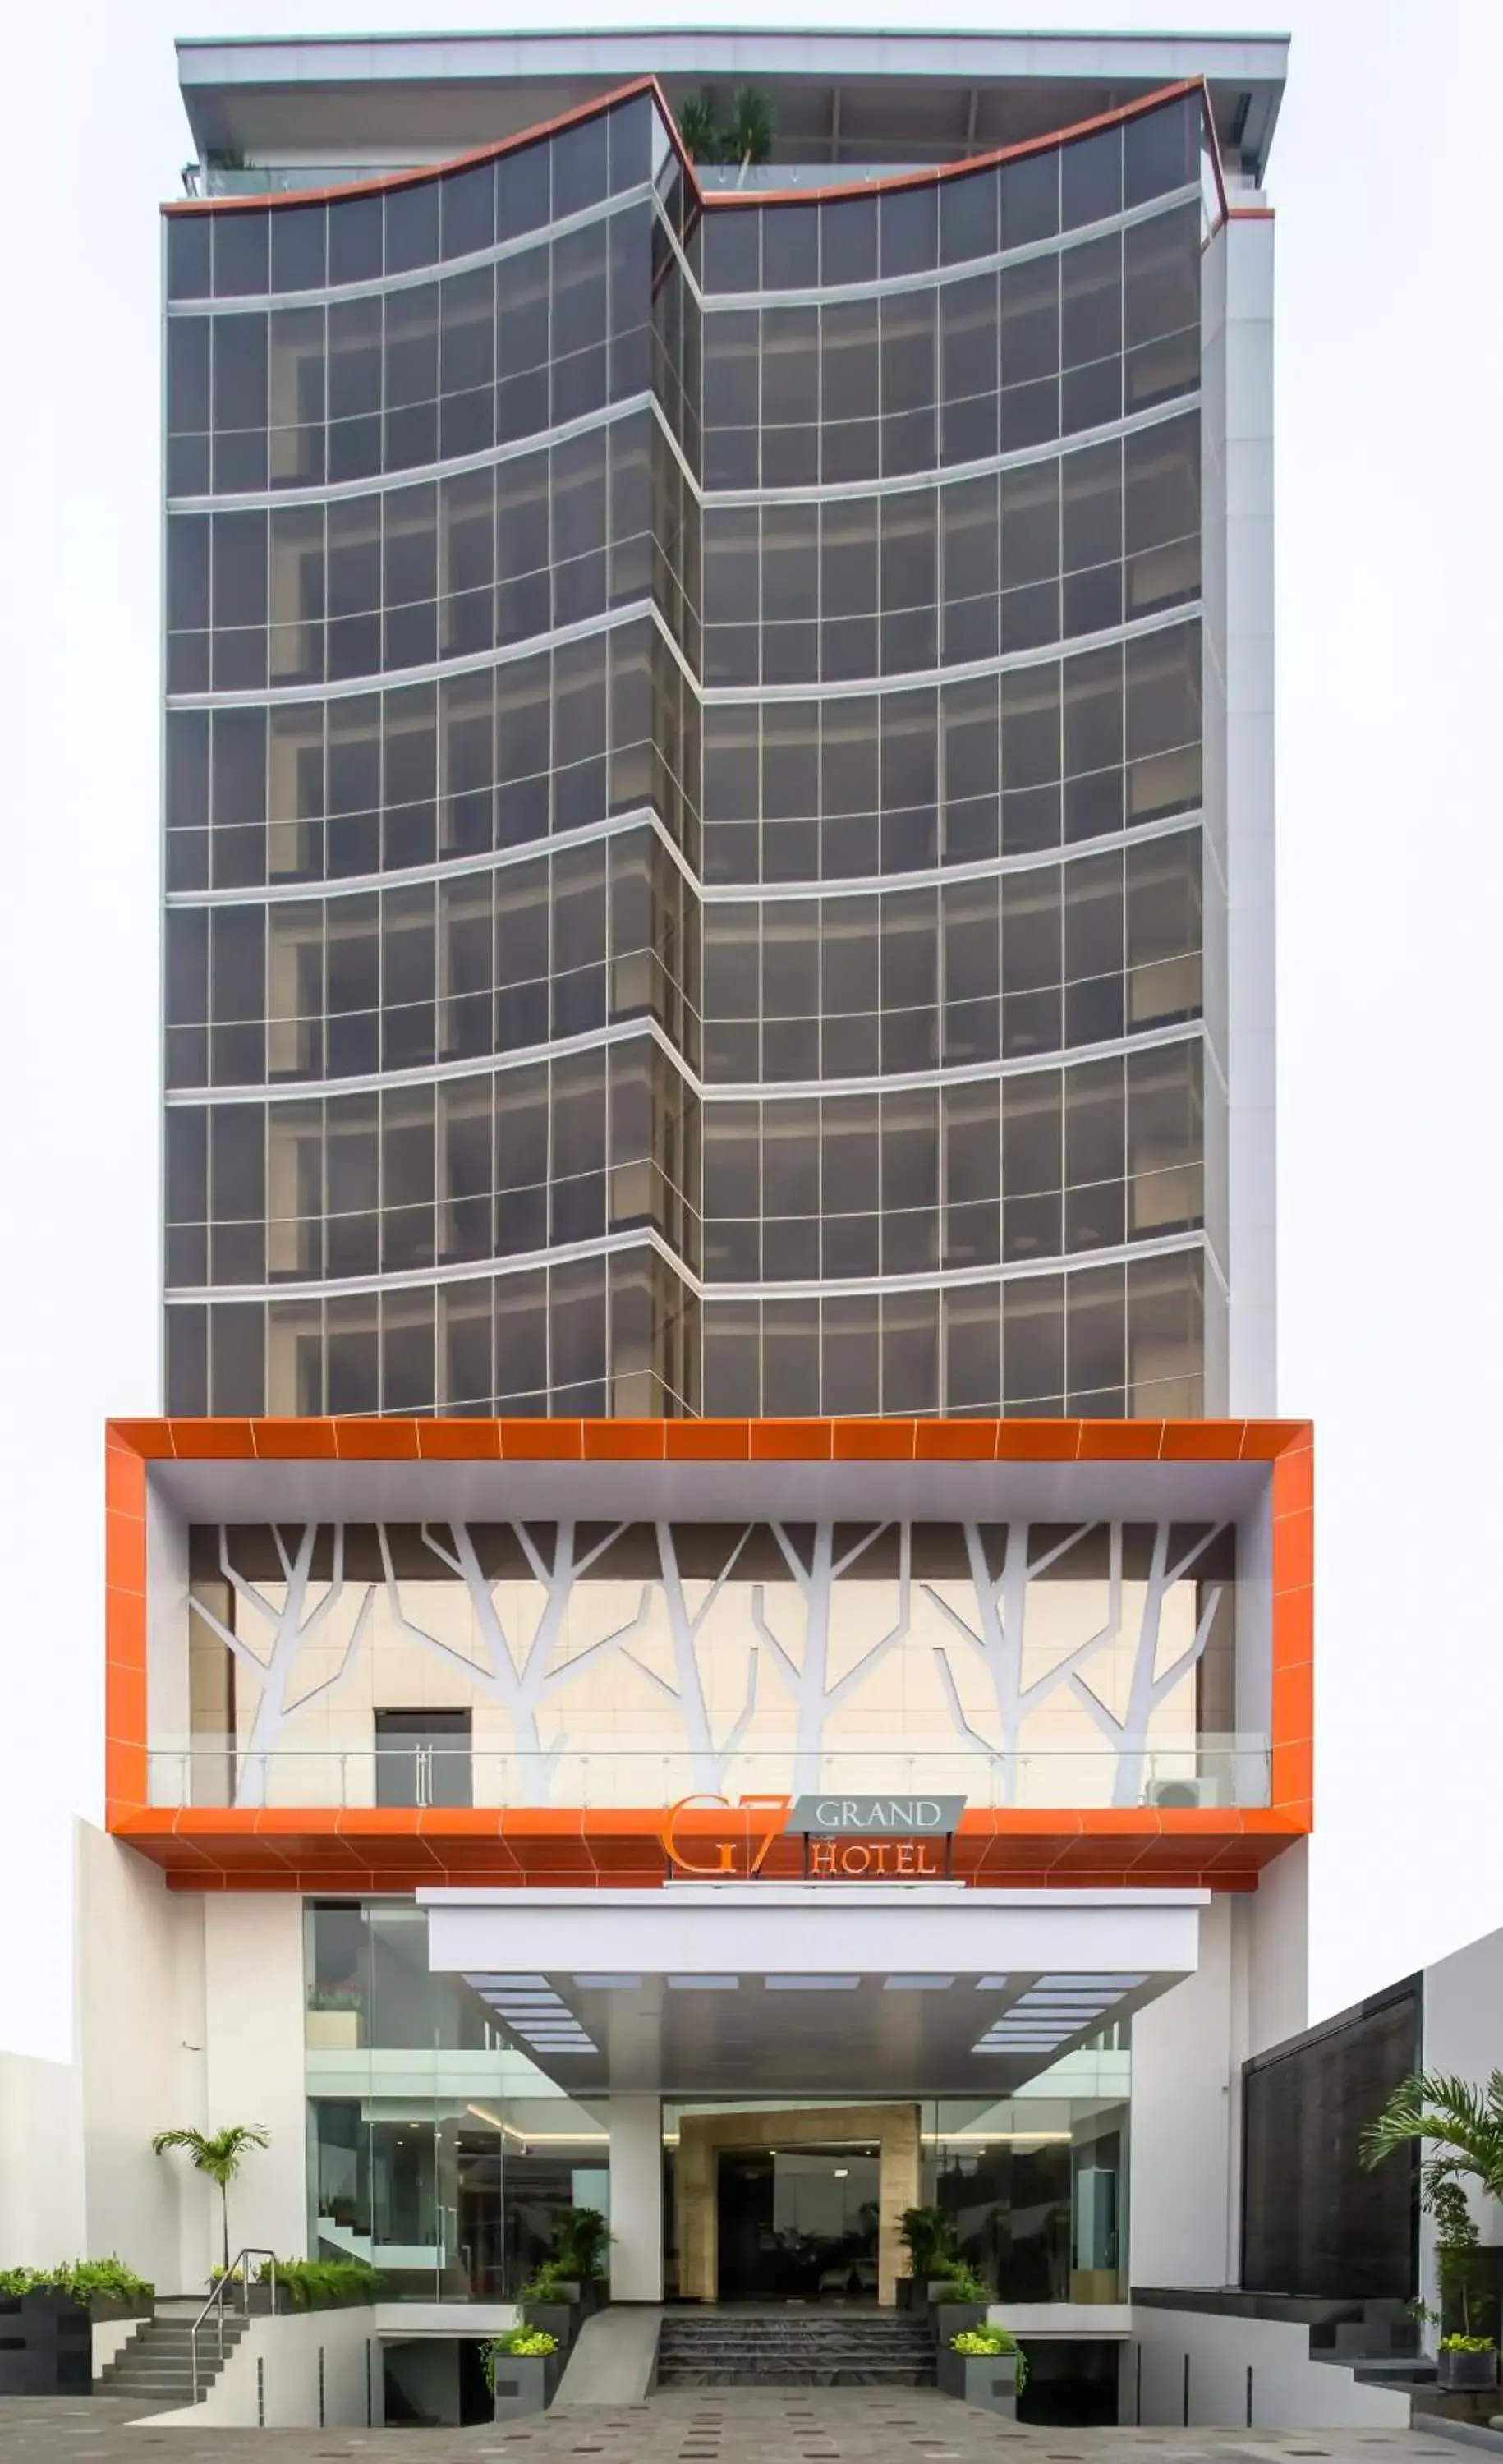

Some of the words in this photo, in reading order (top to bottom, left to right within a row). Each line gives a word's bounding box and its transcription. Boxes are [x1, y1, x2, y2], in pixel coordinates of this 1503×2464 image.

[816, 1800, 942, 1827] GRAND
[660, 1795, 792, 1873] G7
[811, 1844, 936, 1873] HOTEL
